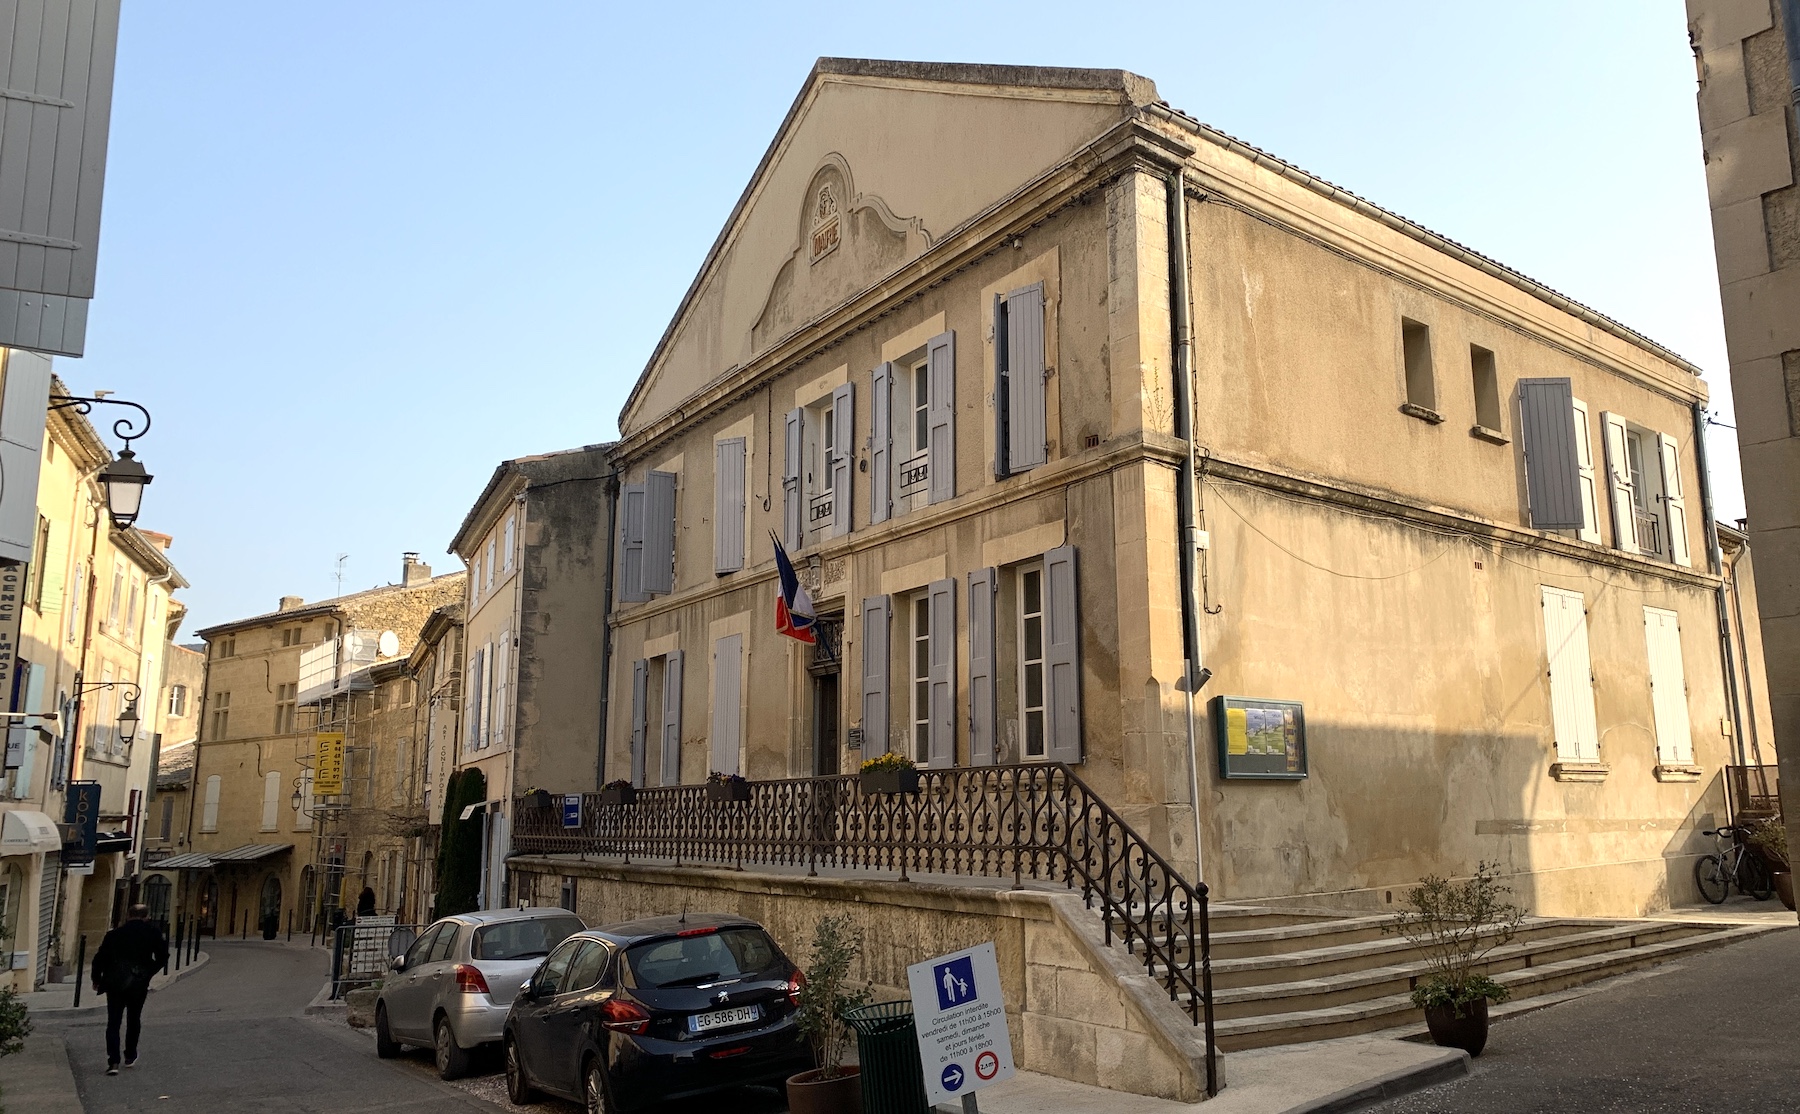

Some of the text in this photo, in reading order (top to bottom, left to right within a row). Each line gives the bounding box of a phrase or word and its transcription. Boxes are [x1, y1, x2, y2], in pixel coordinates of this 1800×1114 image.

[0, 565, 18, 621] AGENCE
[437, 745, 446, 809] CONTEMPORAIN
[921, 1025, 948, 1039] vendredi
[959, 1015, 977, 1026] 11h00
[984, 1007, 1002, 1019] 15h00
[932, 1003, 989, 1026] Circulation interdite
[936, 1022, 990, 1044] samedi, dimanche
[952, 1039, 968, 1050] jours
[968, 1033, 986, 1043] fériés
[949, 1048, 968, 1059] 11h00
[975, 1039, 993, 1051] 18h00
